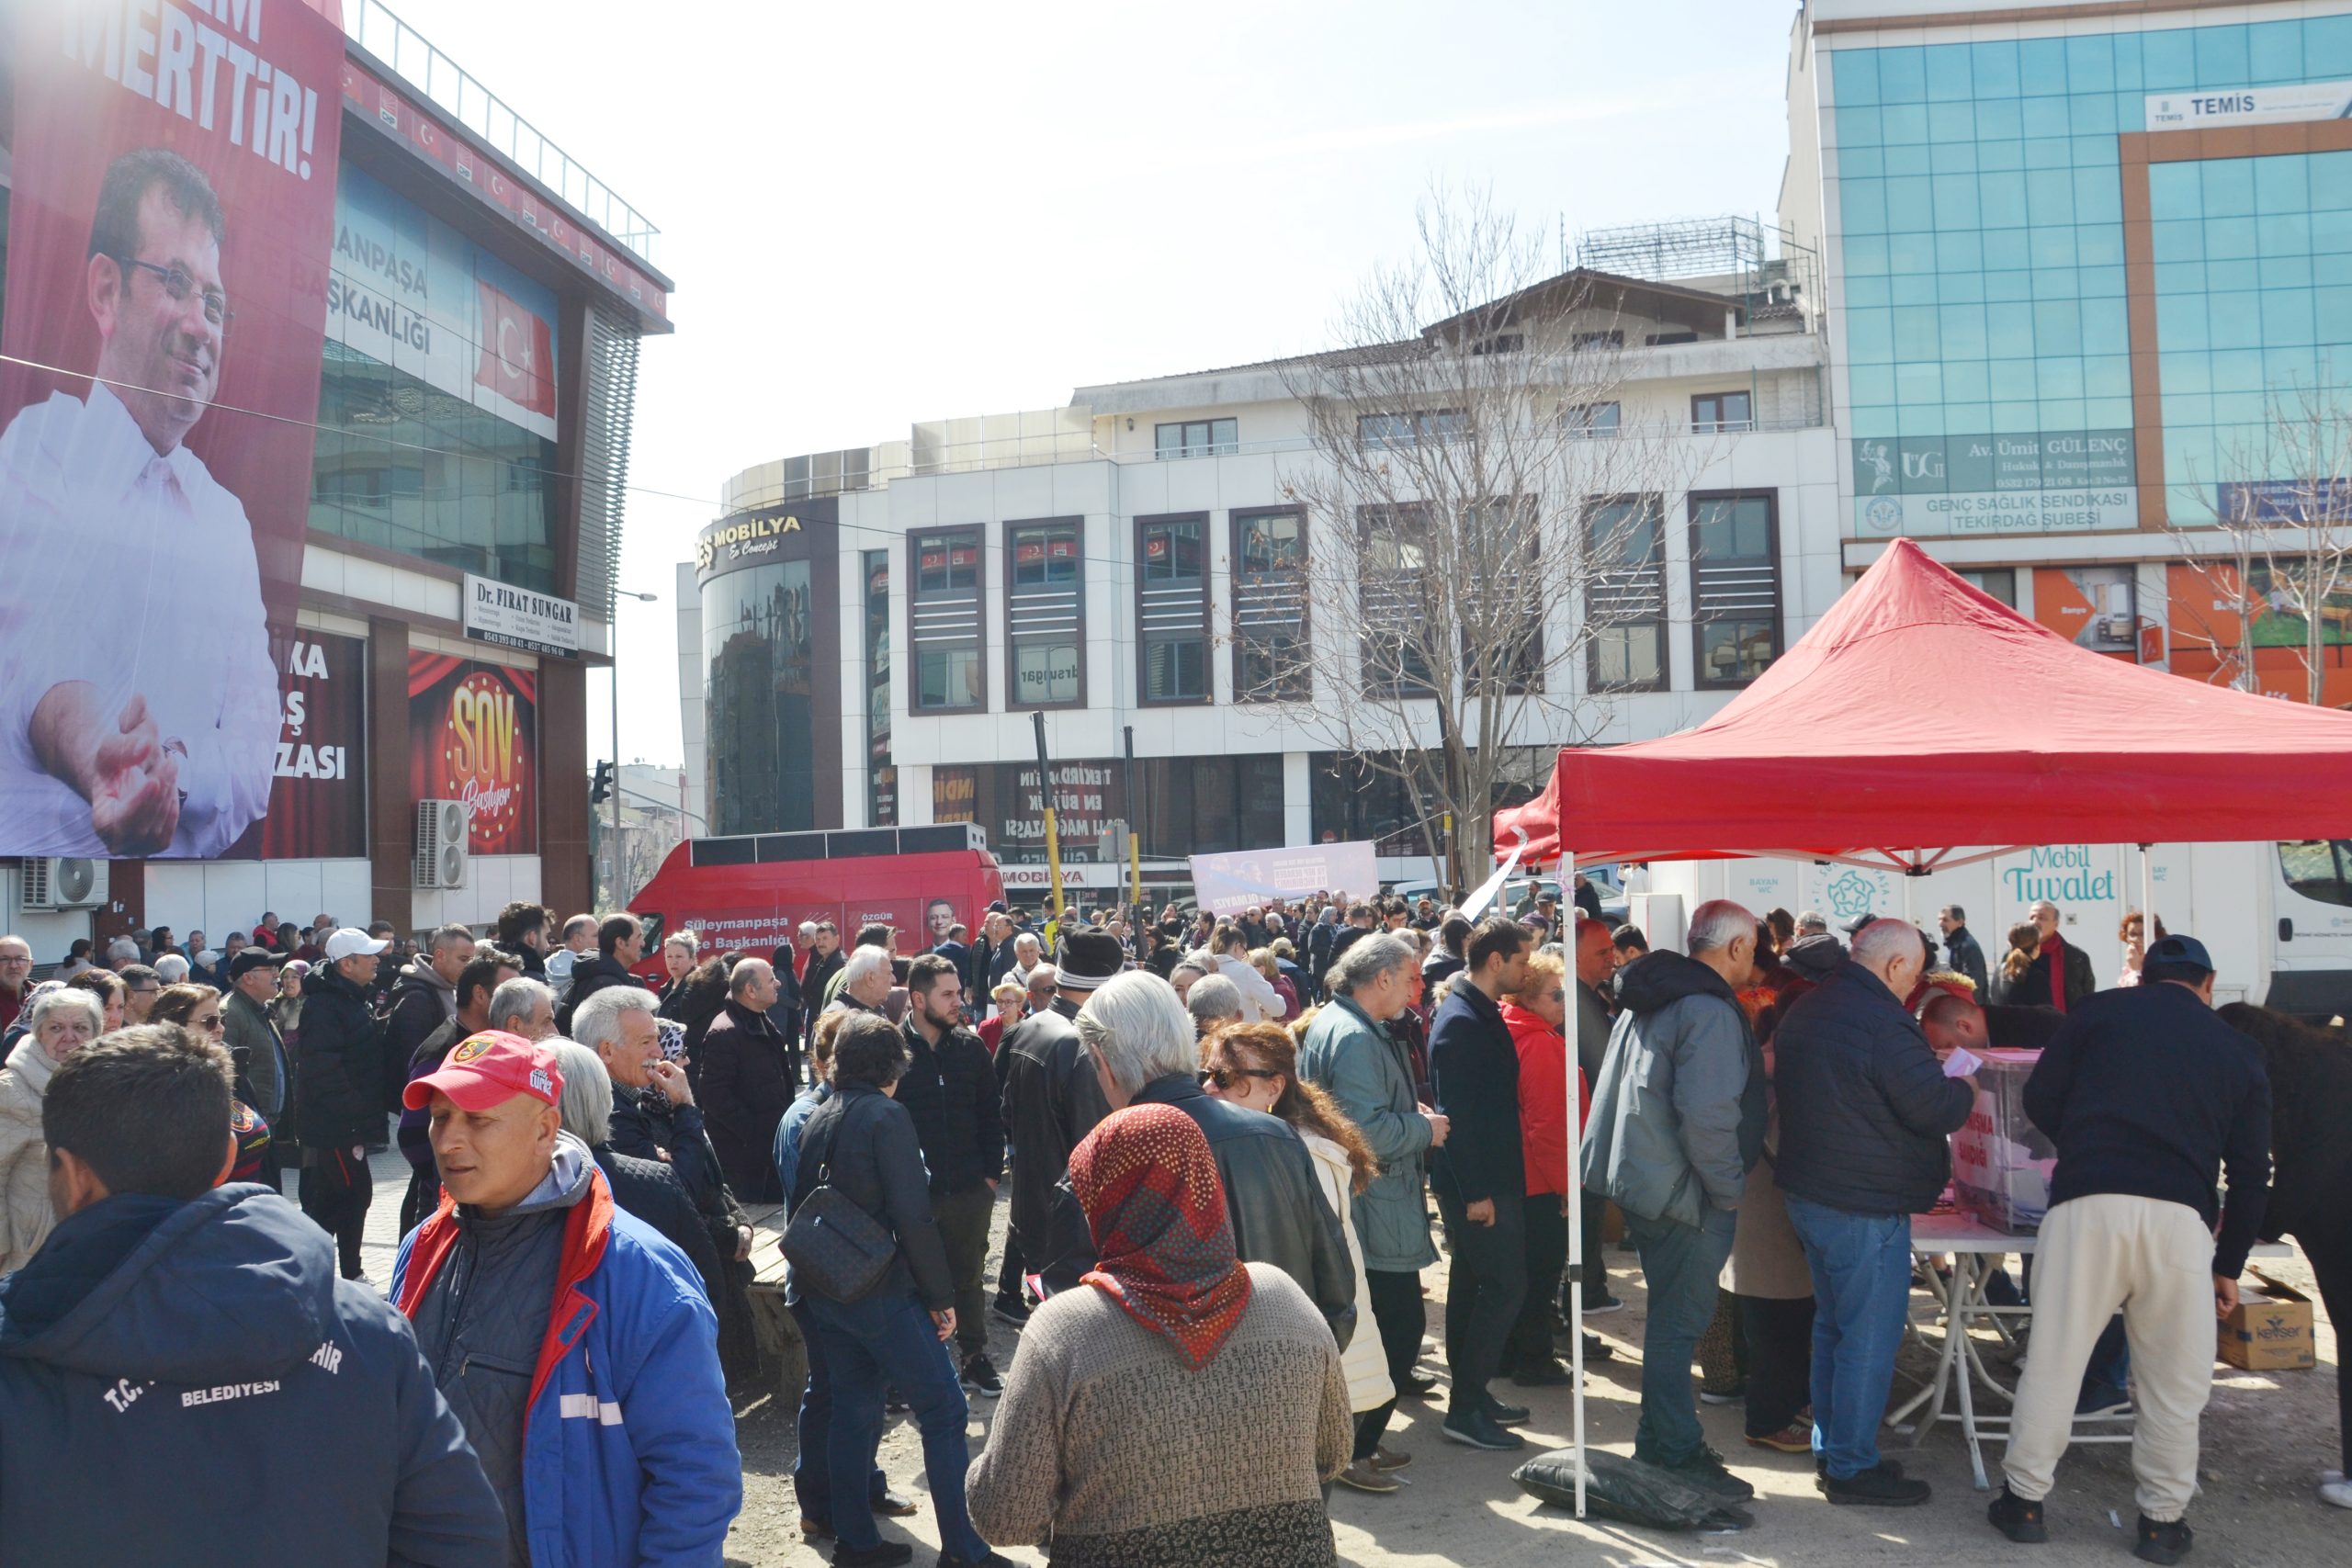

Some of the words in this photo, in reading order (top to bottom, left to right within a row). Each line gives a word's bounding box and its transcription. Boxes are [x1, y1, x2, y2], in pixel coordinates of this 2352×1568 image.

[2191, 93, 2256, 116] TEMİS
[332, 225, 428, 300] ANPAŞA
[327, 278, 431, 356] ŞKANLIĞI
[1969, 443, 1994, 457] Av.
[1998, 439, 2040, 457] Ümit
[2047, 437, 2128, 455] GÜLENÇ
[1926, 499, 1973, 514] GENÇ
[1976, 493, 2036, 511] SAĞLIK
[2041, 490, 2128, 509] SENDİKASI
[714, 515, 801, 547] MOBİLYA
[1955, 511, 2037, 529] TEKİRDAĞ
[2042, 508, 2101, 530] ŞUBESİ
[741, 537, 778, 556] Concept
[477, 582, 493, 604] Dr.
[497, 587, 529, 613] FIRAT
[532, 597, 571, 624] SUNGAR
[282, 691, 306, 737] Ş
[461, 775, 511, 819] Başlıyor
[2030, 844, 2091, 871] Mobil
[1001, 868, 1085, 883] MOBİYA
[2003, 867, 2116, 902] Tuvalet
[684, 915, 788, 932] Süleymanpaşa
[862, 912, 893, 921] ÖZGÜR
[103, 1378, 143, 1414] T.C.
[309, 1339, 343, 1375] HİR
